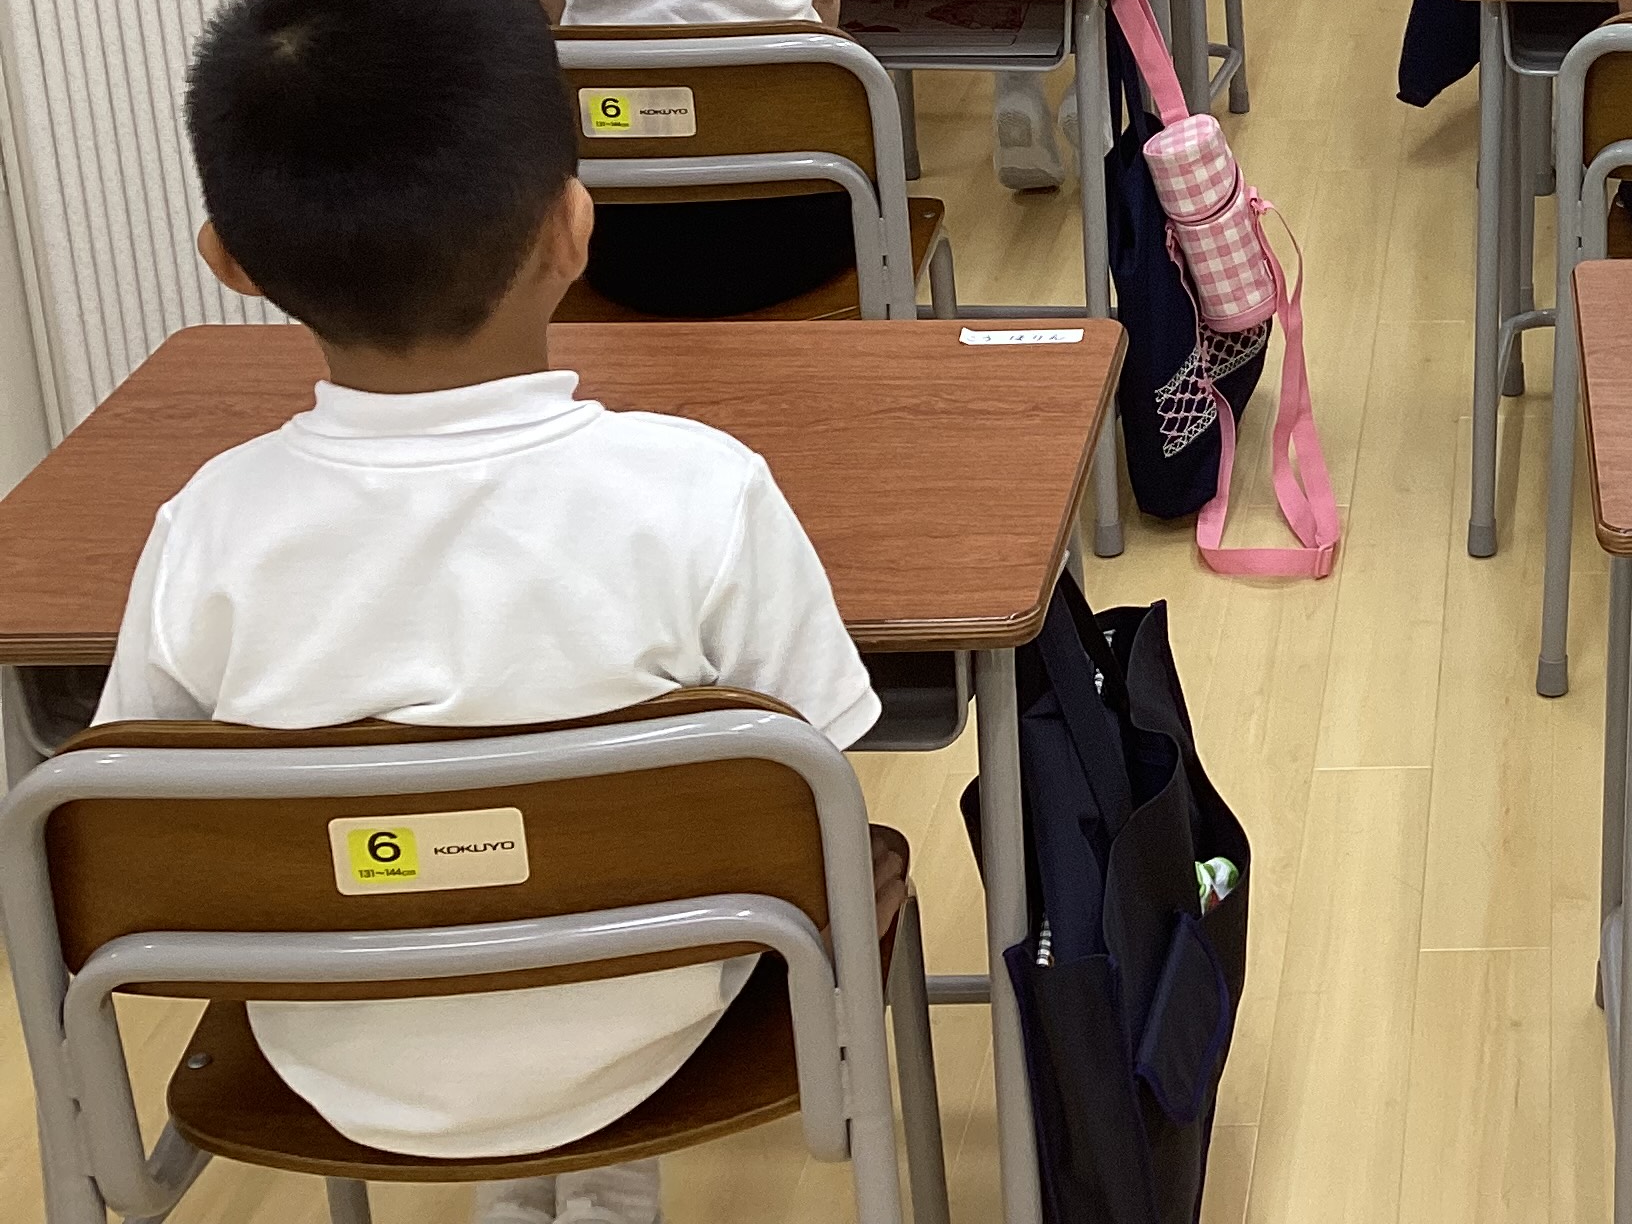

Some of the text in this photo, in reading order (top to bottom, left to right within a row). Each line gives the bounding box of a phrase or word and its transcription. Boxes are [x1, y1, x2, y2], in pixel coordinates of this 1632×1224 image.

[601, 97, 621, 118] 6
[367, 831, 401, 863] 6
[434, 840, 515, 855] KOKUYO
